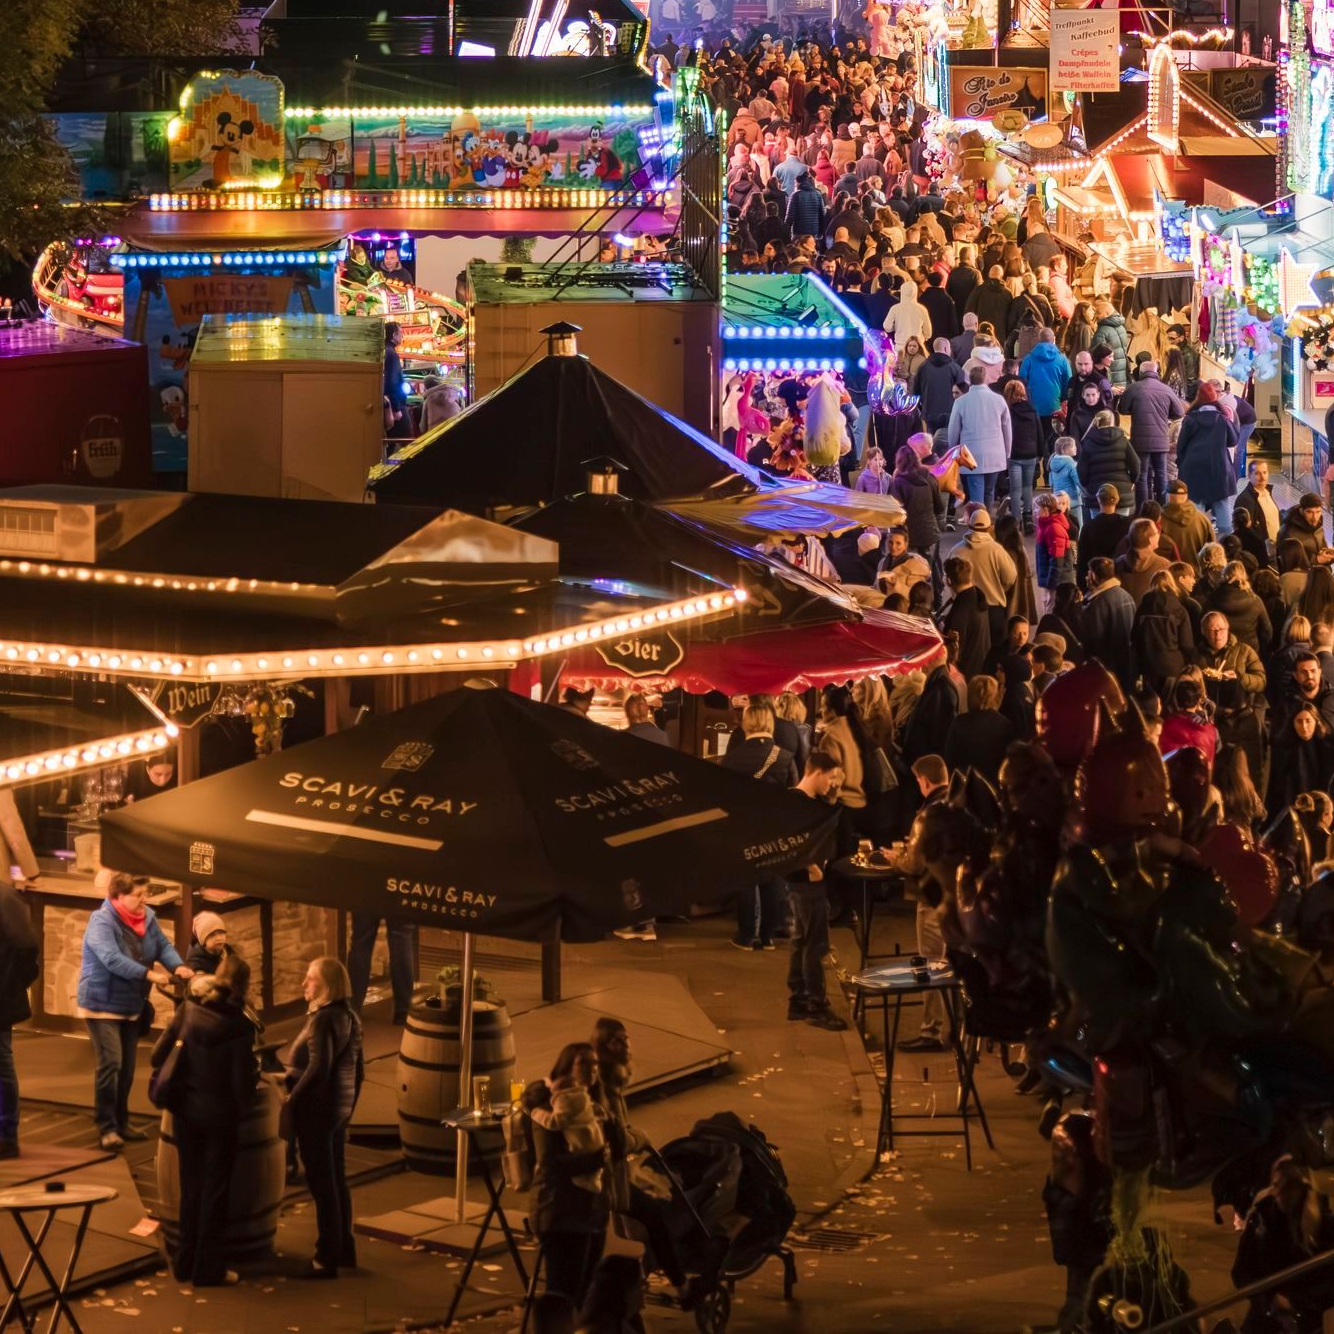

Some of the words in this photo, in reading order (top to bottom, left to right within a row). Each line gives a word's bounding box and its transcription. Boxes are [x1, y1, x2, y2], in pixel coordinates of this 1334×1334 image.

[1055, 17, 1094, 30] Treffpunkt
[1070, 26, 1115, 41] Kaffeebud
[1058, 59, 1111, 68] Dampfnudeln
[167, 681, 212, 715] Wein
[279, 771, 378, 800] SCAVI
[378, 788, 406, 807] &
[410, 794, 478, 816] RAY
[554, 784, 628, 813] SCAVI
[637, 770, 682, 790] RAY
[294, 795, 430, 825] PROSECCO
[743, 839, 777, 861] SCAVI
[787, 831, 811, 847] RAY
[386, 877, 443, 899] SCAVI
[444, 886, 458, 903] &
[461, 890, 496, 907] RAY
[401, 898, 478, 919] PROSECCO
